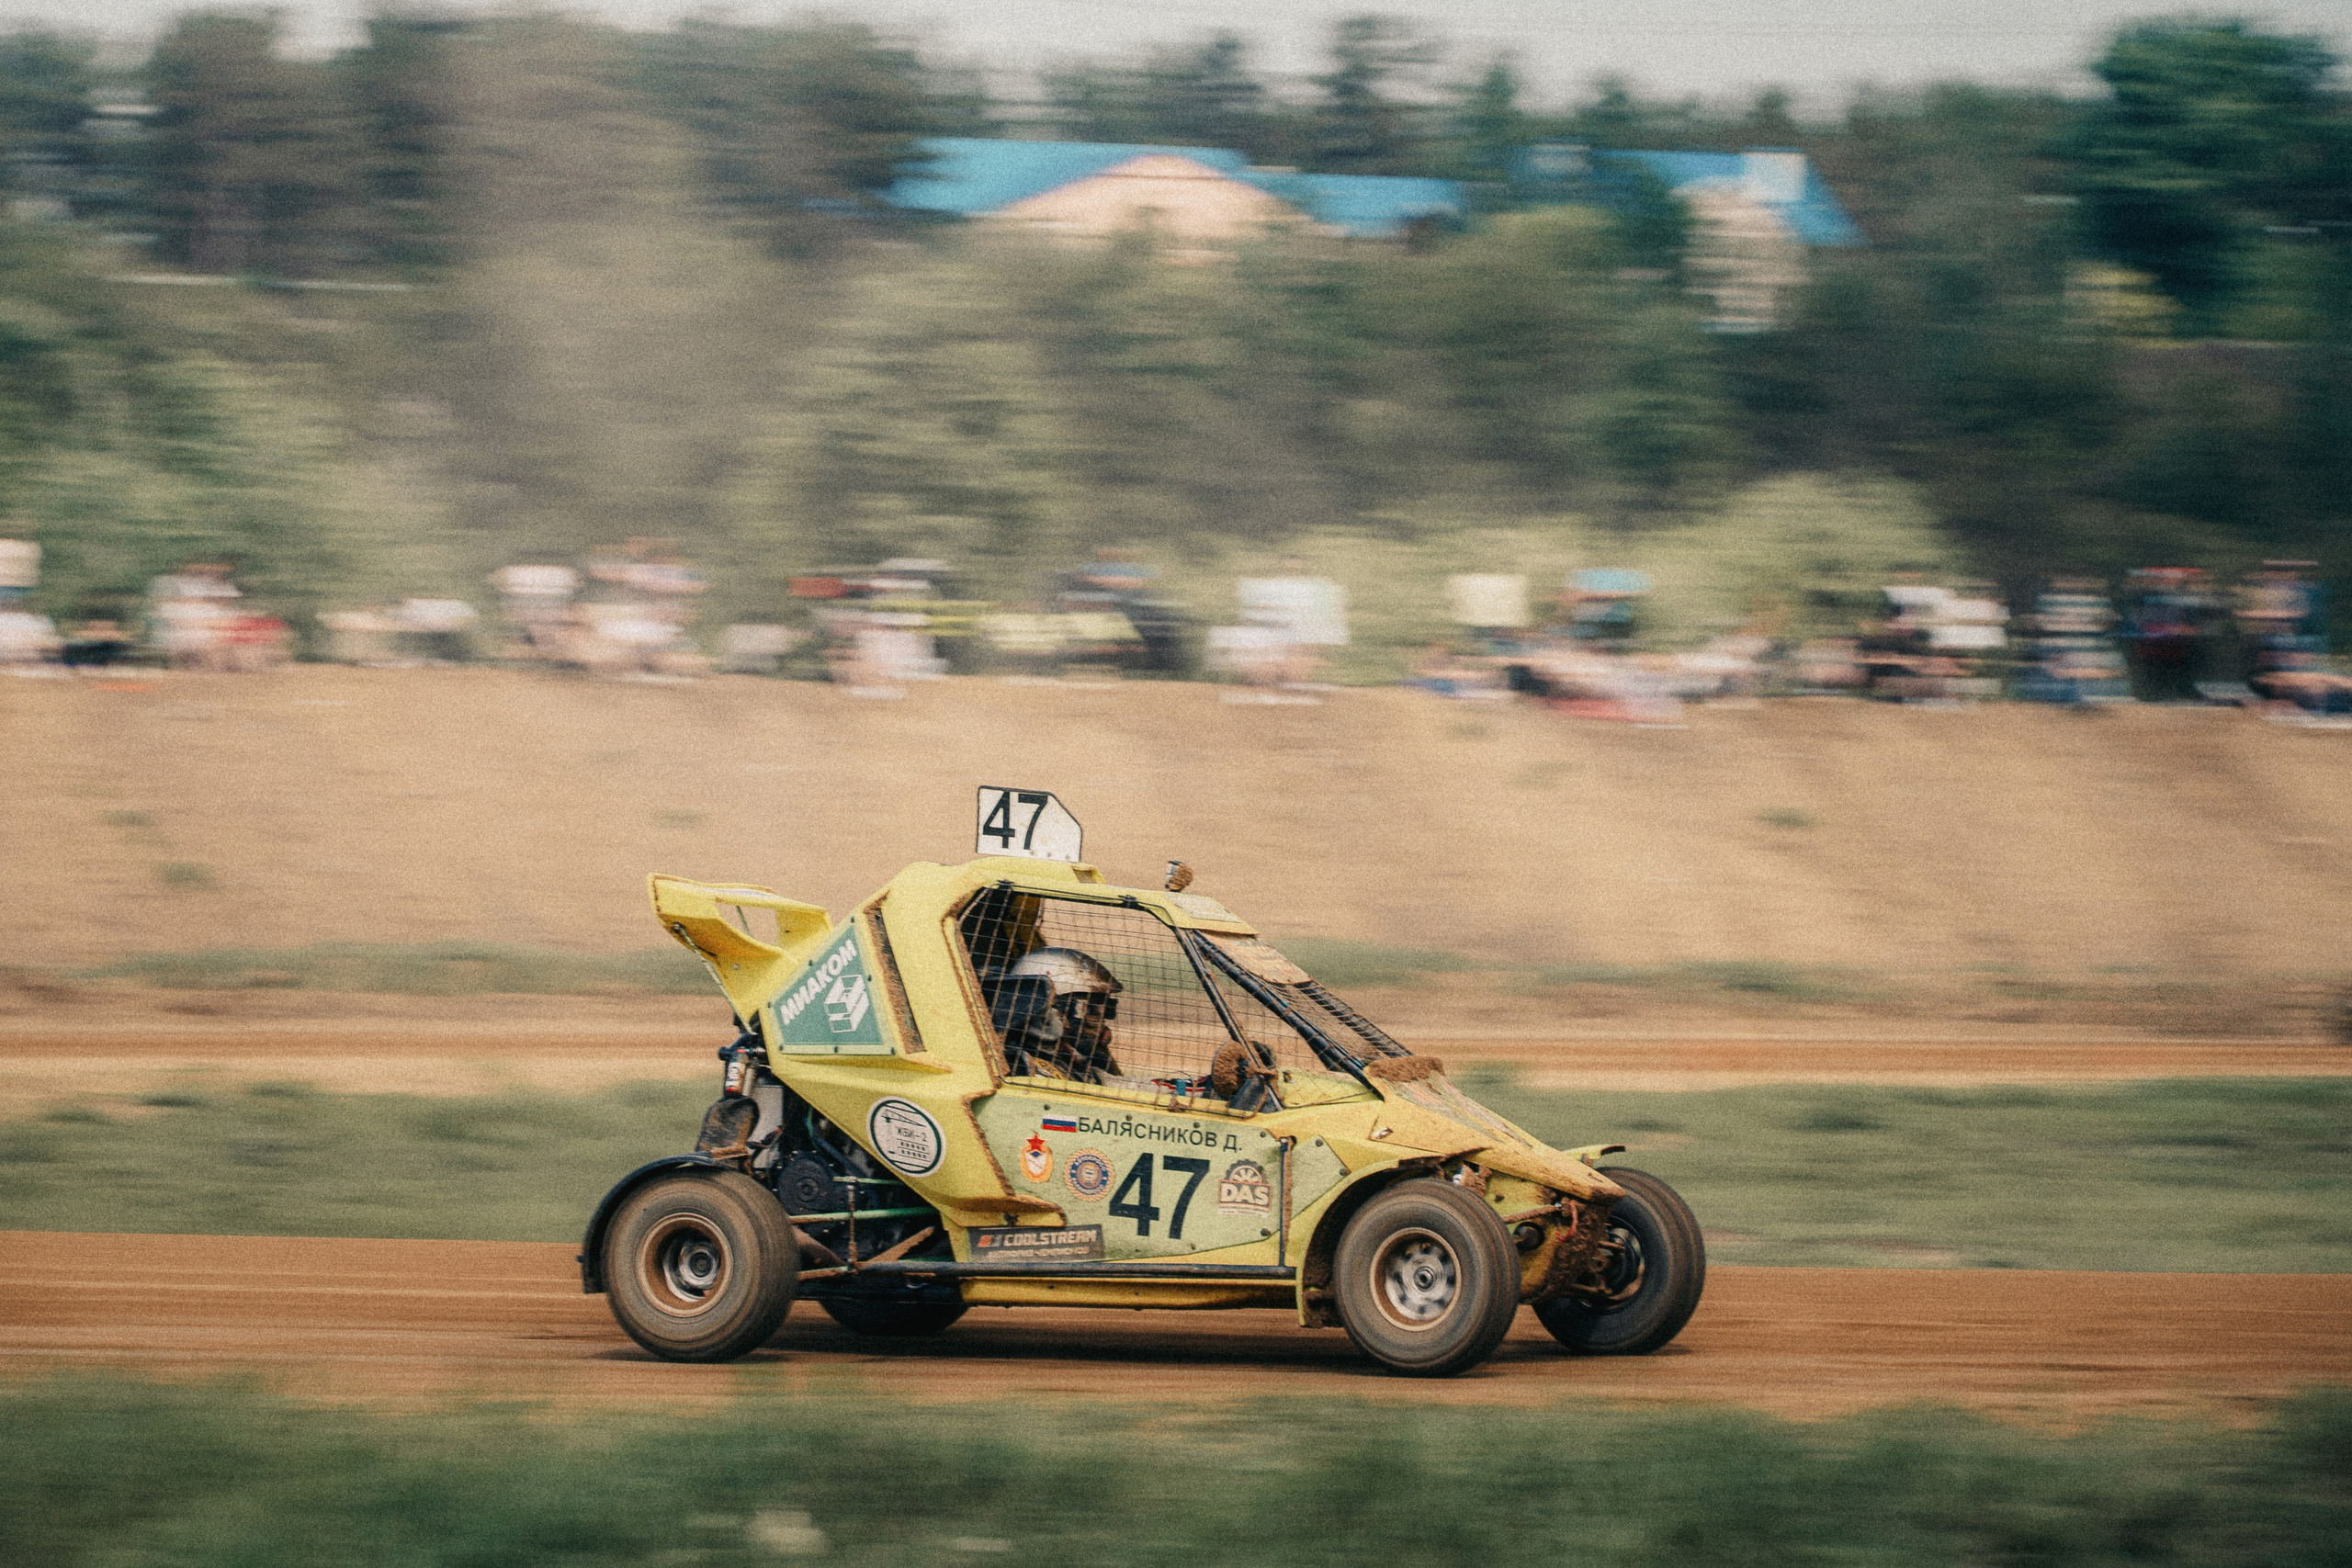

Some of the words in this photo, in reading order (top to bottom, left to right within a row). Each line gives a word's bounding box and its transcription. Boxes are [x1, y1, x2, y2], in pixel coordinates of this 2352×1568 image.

[983, 792, 1047, 850] 47
[780, 940, 857, 1025] МИАКОМ
[1079, 1117, 1216, 1146] БАЛЯСНИКОВ
[1109, 1152, 1210, 1239] 47
[1220, 1183, 1269, 1205] DAS
[1003, 1230, 1097, 1246] COOLSTREAM
